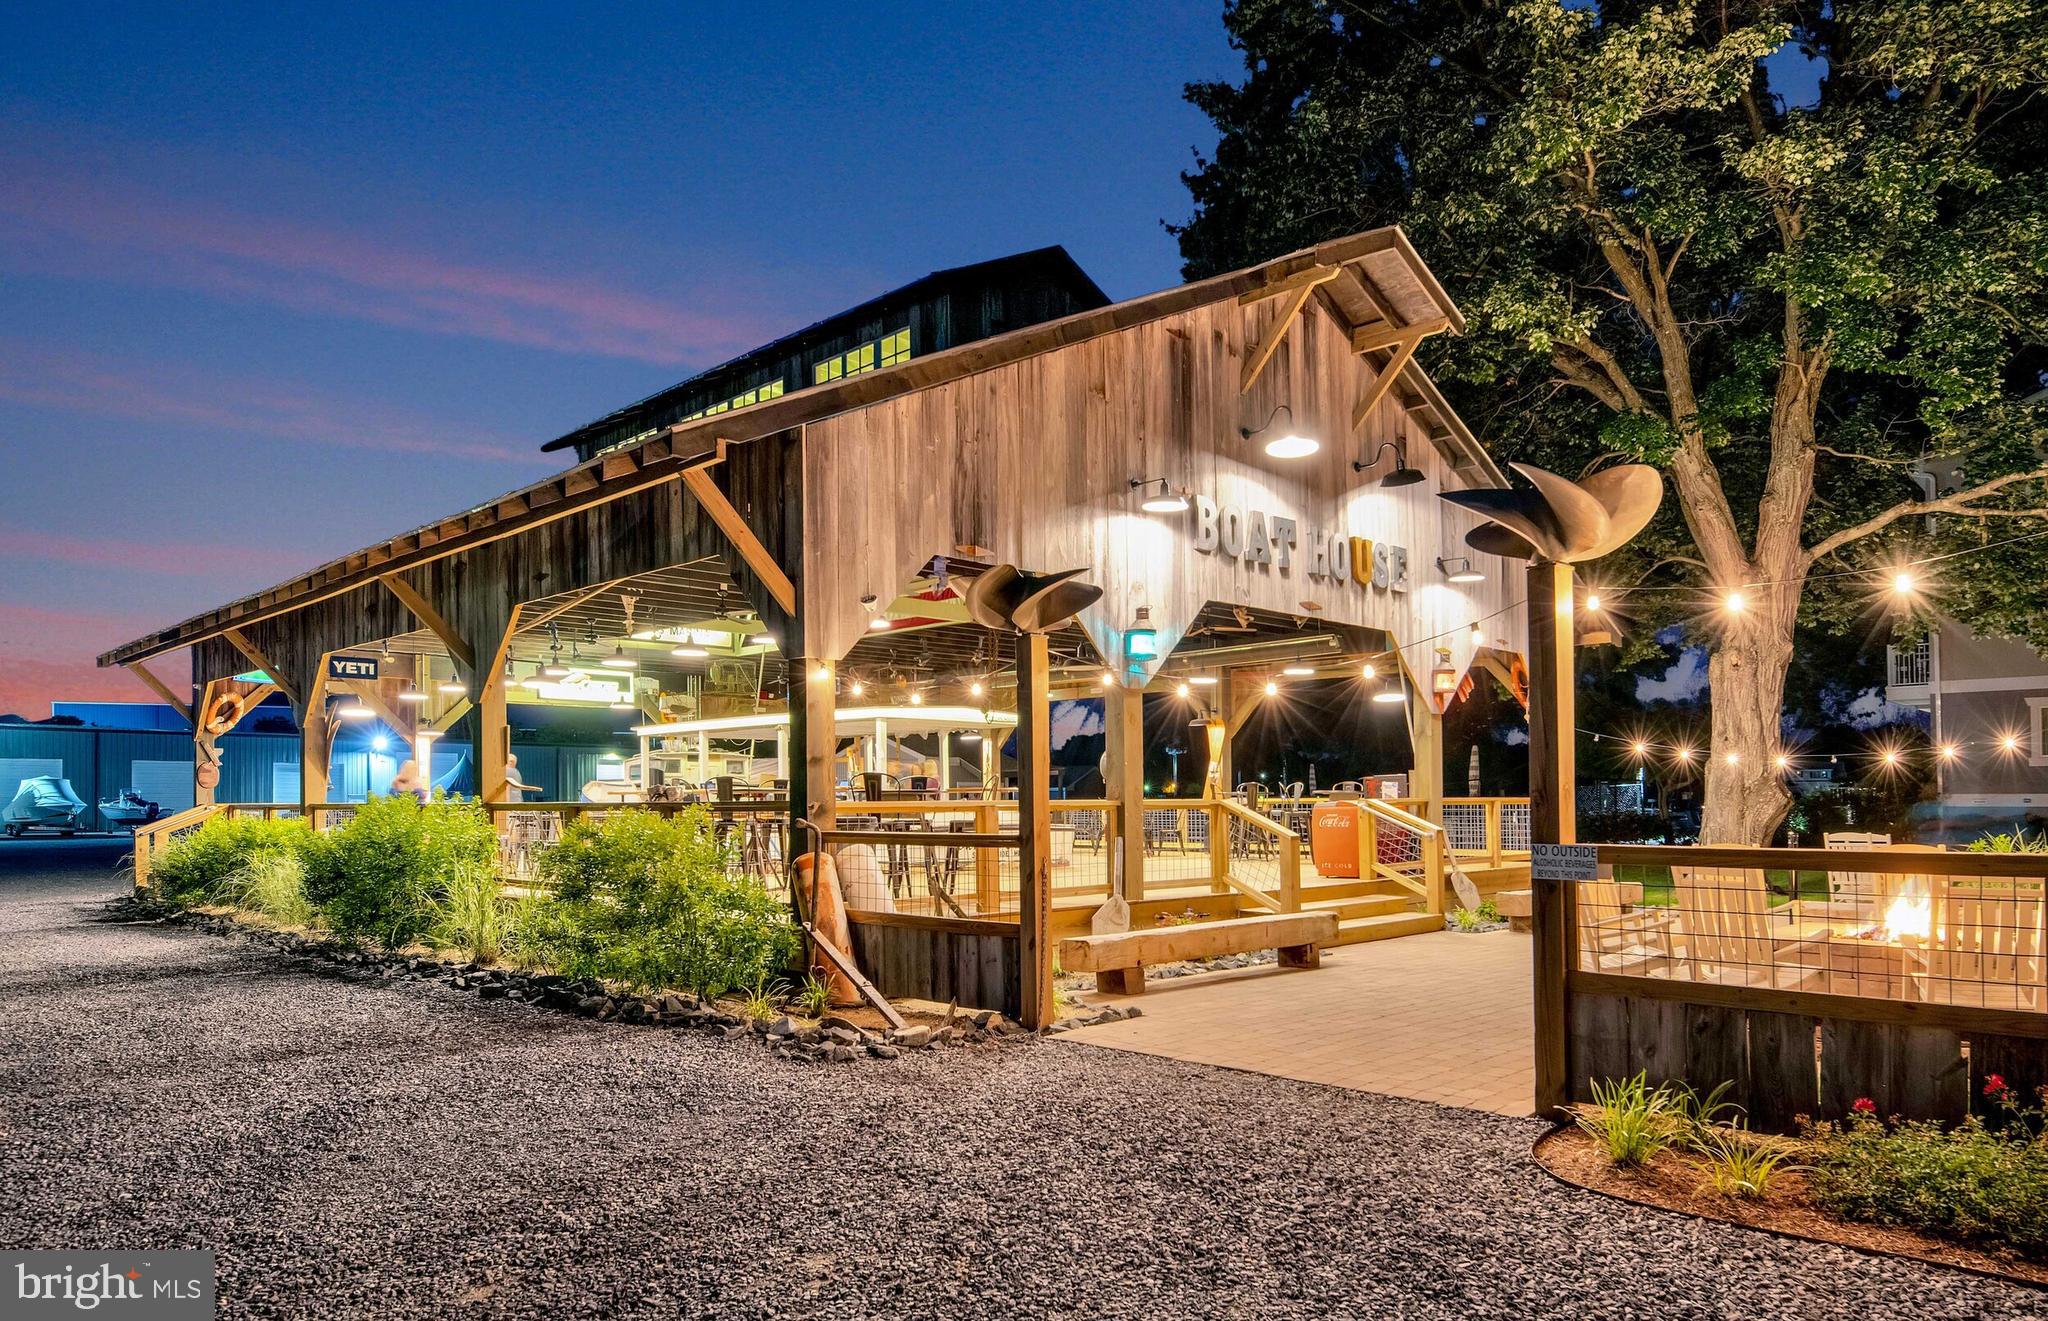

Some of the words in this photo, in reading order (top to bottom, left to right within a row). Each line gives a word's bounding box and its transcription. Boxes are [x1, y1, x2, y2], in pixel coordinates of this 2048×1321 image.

[1194, 495, 1297, 569] BOAT
[1308, 526, 1408, 593] HOUSE
[333, 661, 375, 675] YETI
[1532, 845, 1548, 856] NO
[1551, 846, 1597, 858] OUTSIDE
[1533, 859, 1564, 868] ALCOHOLIC
[1564, 860, 1596, 869] BEVERAGES
[1537, 869, 1559, 878] BEYOND
[1561, 870, 1573, 879] THIS
[1574, 871, 1591, 879] POINT
